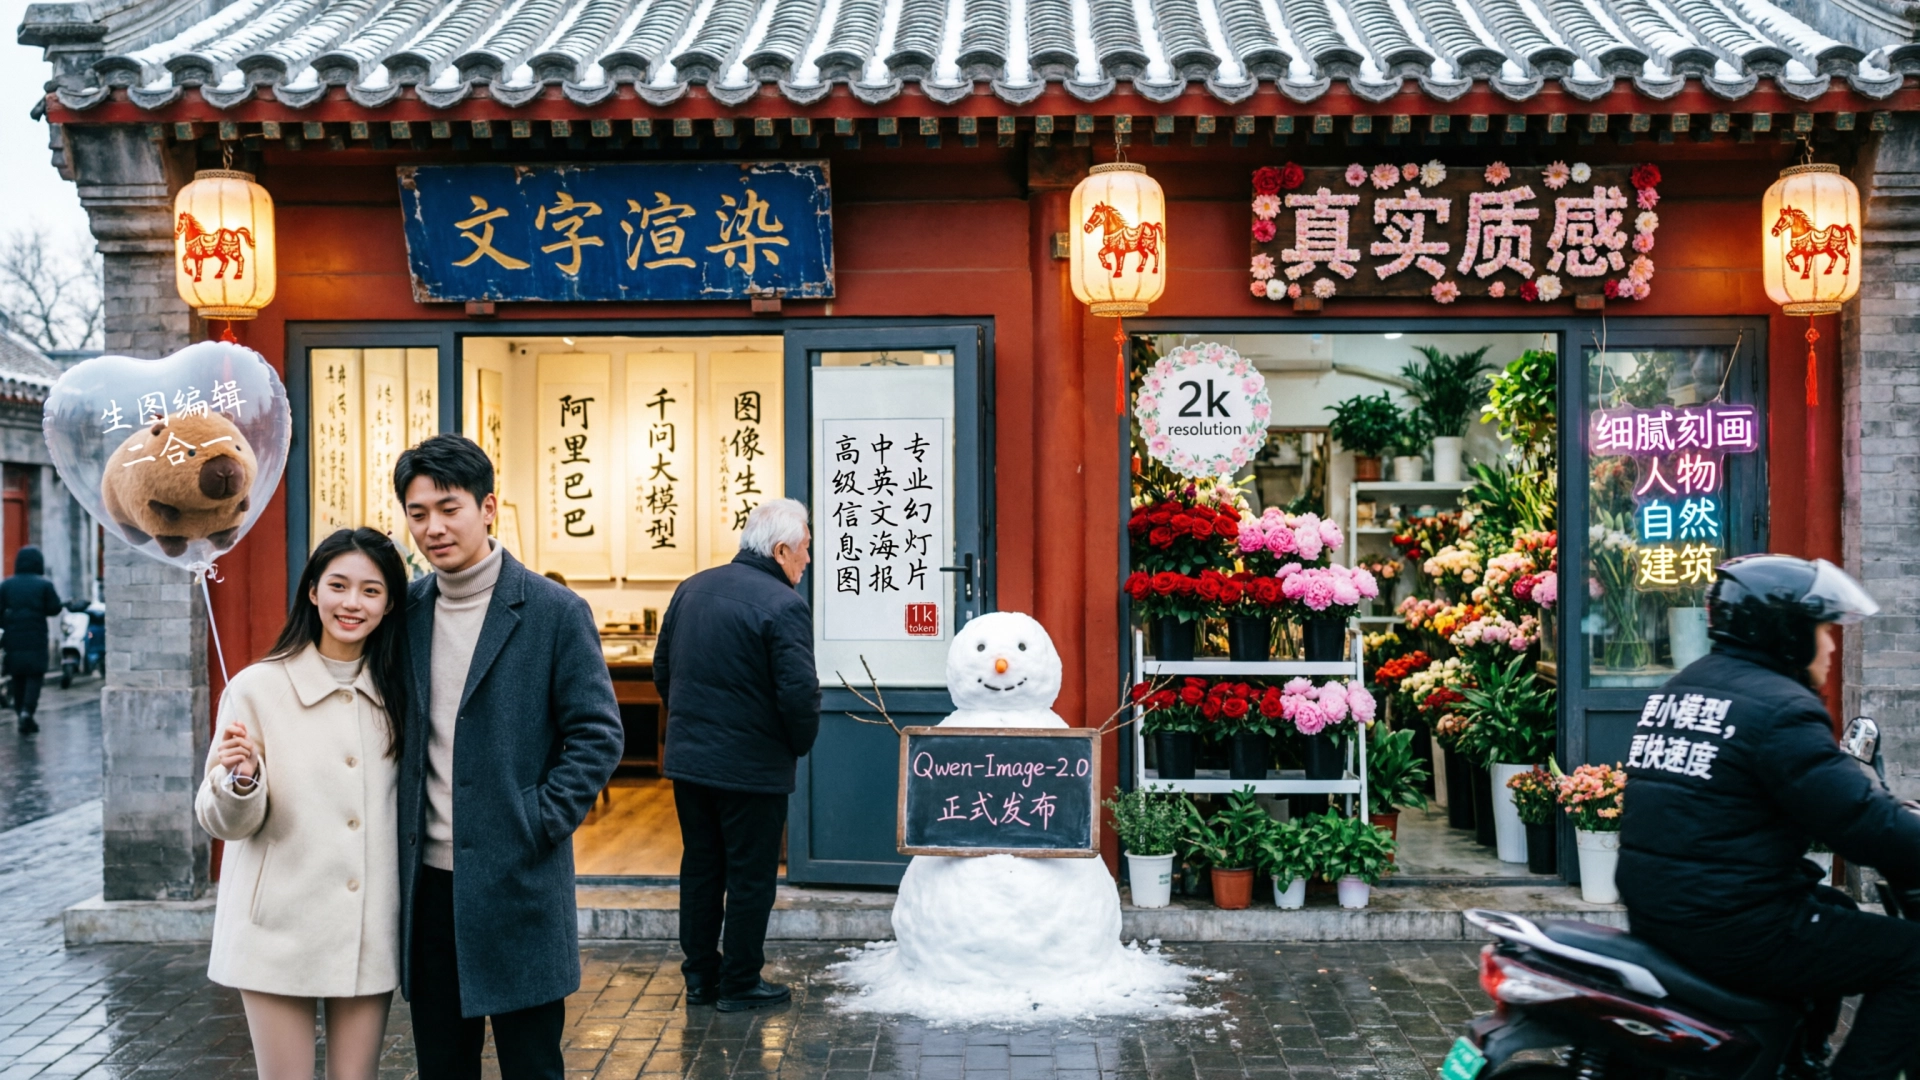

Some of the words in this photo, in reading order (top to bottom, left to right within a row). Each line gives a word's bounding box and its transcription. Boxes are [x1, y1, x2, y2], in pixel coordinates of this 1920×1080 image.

[451, 188, 790, 276] 文字渲染
[1281, 185, 1629, 280] 真实质感
[101, 379, 247, 434] 生图编辑
[1178, 379, 1231, 418] 2k
[122, 432, 233, 467] 二合一
[1168, 422, 1242, 436] resolution
[1595, 408, 1753, 451] 细腻刻画
[559, 394, 595, 537] 阿里巴巴
[645, 387, 678, 549] 千问大模型
[1637, 453, 1716, 496] 人物
[831, 434, 865, 596] 高级信息图
[867, 433, 900, 593] 中英文海报
[902, 432, 933, 591] 专业幻灯片
[1643, 497, 1718, 540] 自然
[1639, 542, 1718, 586] 建筑
[908, 623, 935, 634] token
[911, 605, 933, 622] 1k
[913, 751, 1089, 788] Qwen-Image-2.0
[1625, 733, 1720, 781] 更快速度
[936, 791, 1058, 830] 正式发布
